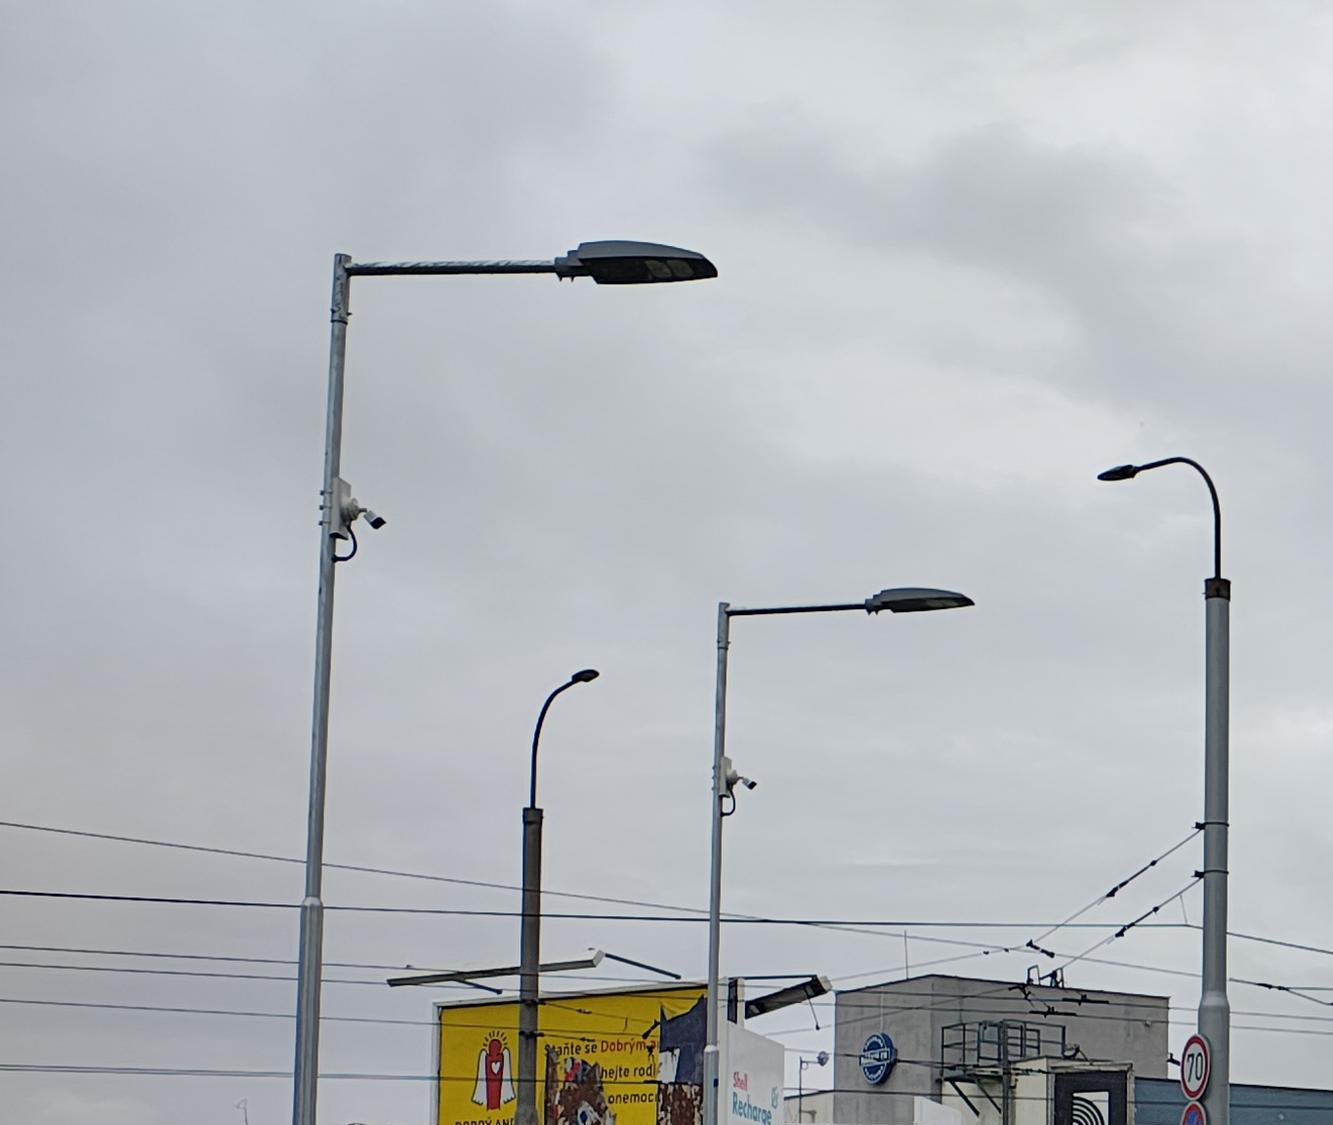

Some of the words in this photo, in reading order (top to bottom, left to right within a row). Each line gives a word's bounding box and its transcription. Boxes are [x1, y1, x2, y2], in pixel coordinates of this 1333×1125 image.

[585, 1044, 598, 1053] se
[601, 1038, 645, 1055] Dobrým
[1186, 1052, 1201, 1083] 70
[733, 1071, 748, 1092] Shell
